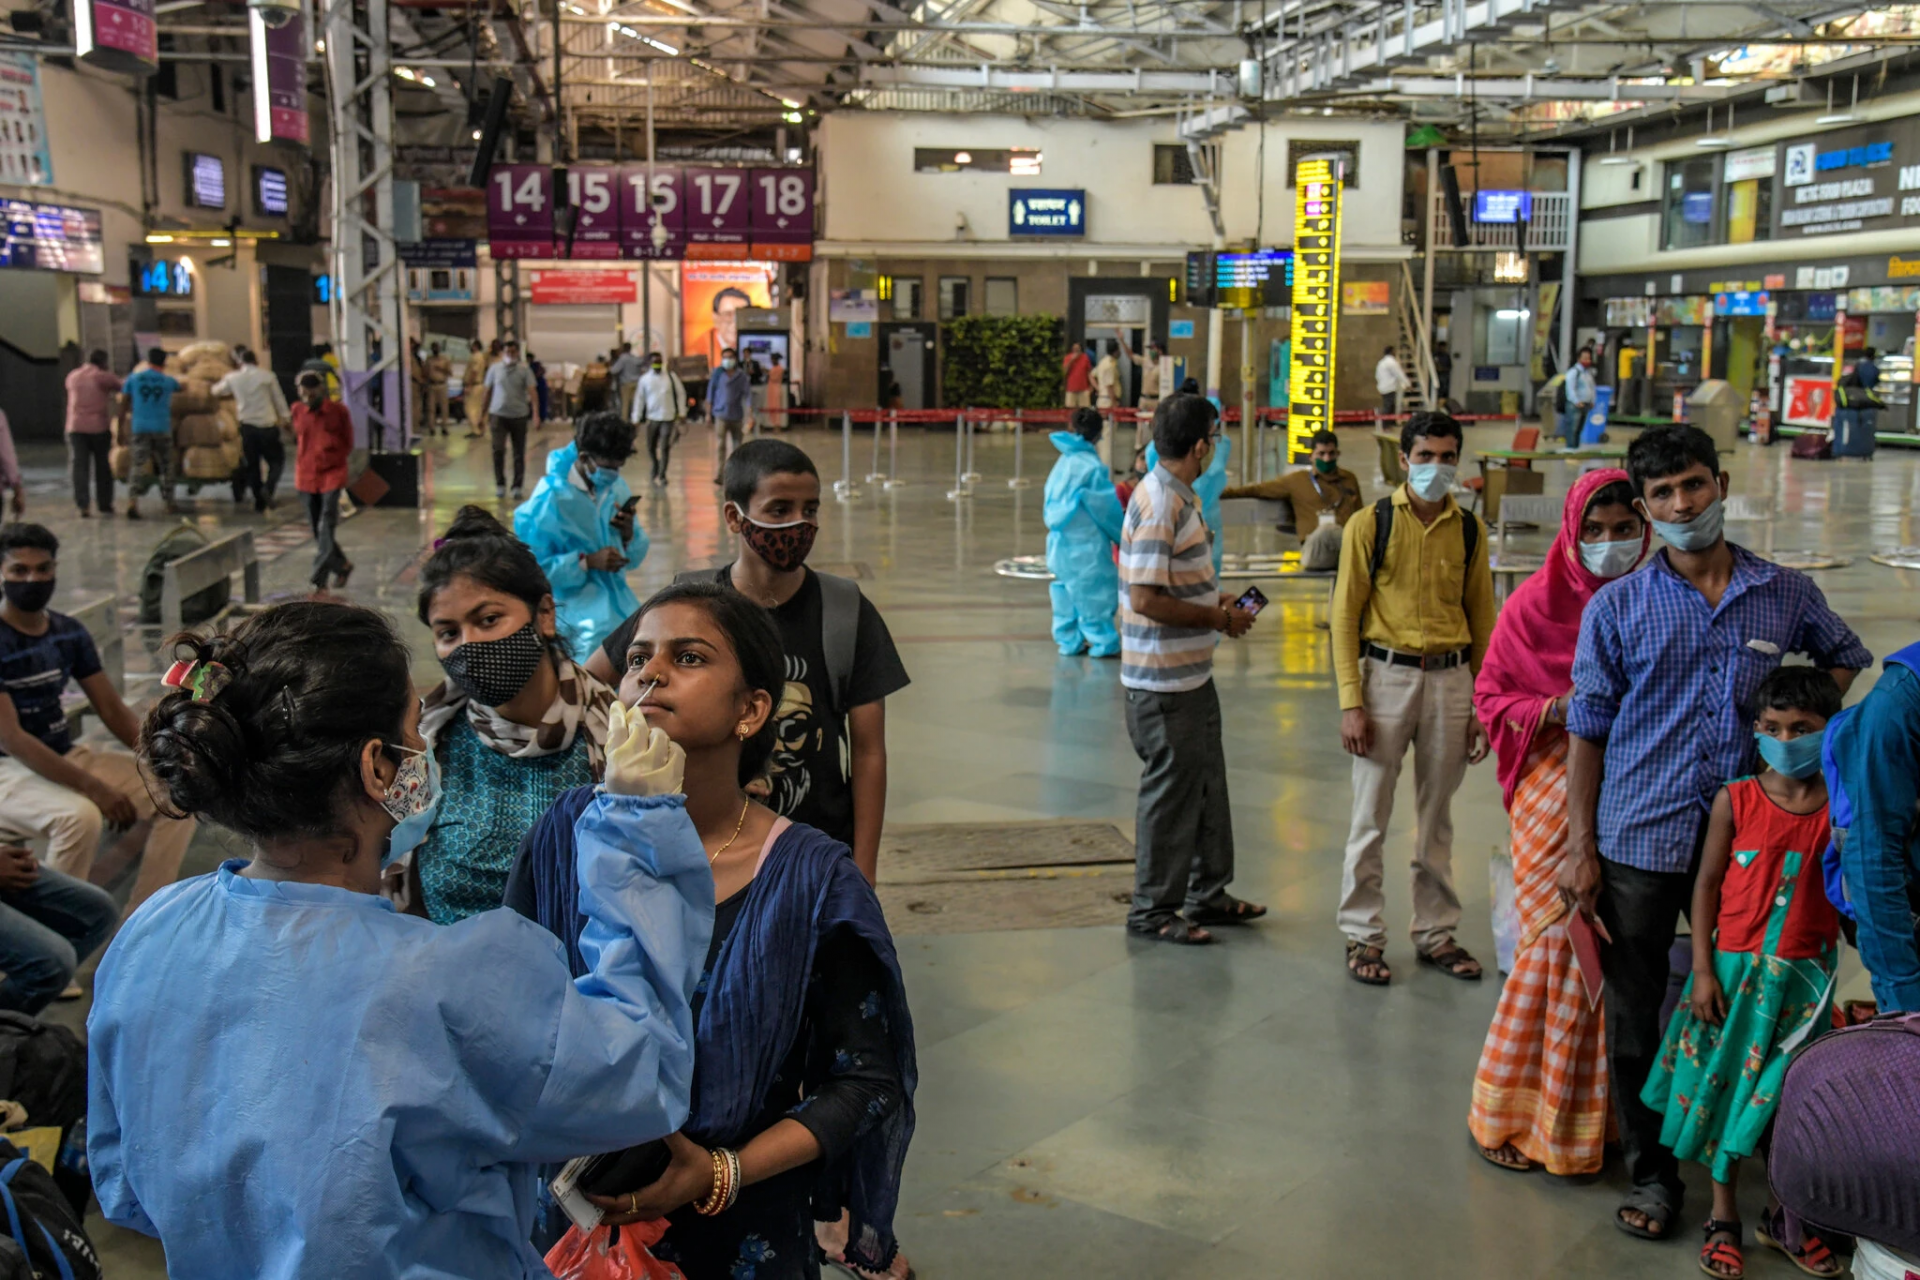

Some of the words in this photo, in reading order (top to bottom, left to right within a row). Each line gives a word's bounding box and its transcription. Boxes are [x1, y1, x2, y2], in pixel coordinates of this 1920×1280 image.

[494, 170, 546, 213] 14
[566, 172, 611, 214] 15
[628, 174, 678, 215] 16
[694, 174, 742, 215] 17
[758, 175, 806, 216] 18
[1027, 214, 1067, 226] TOILET
[142, 260, 169, 293] 14
[139, 384, 164, 402] 99
